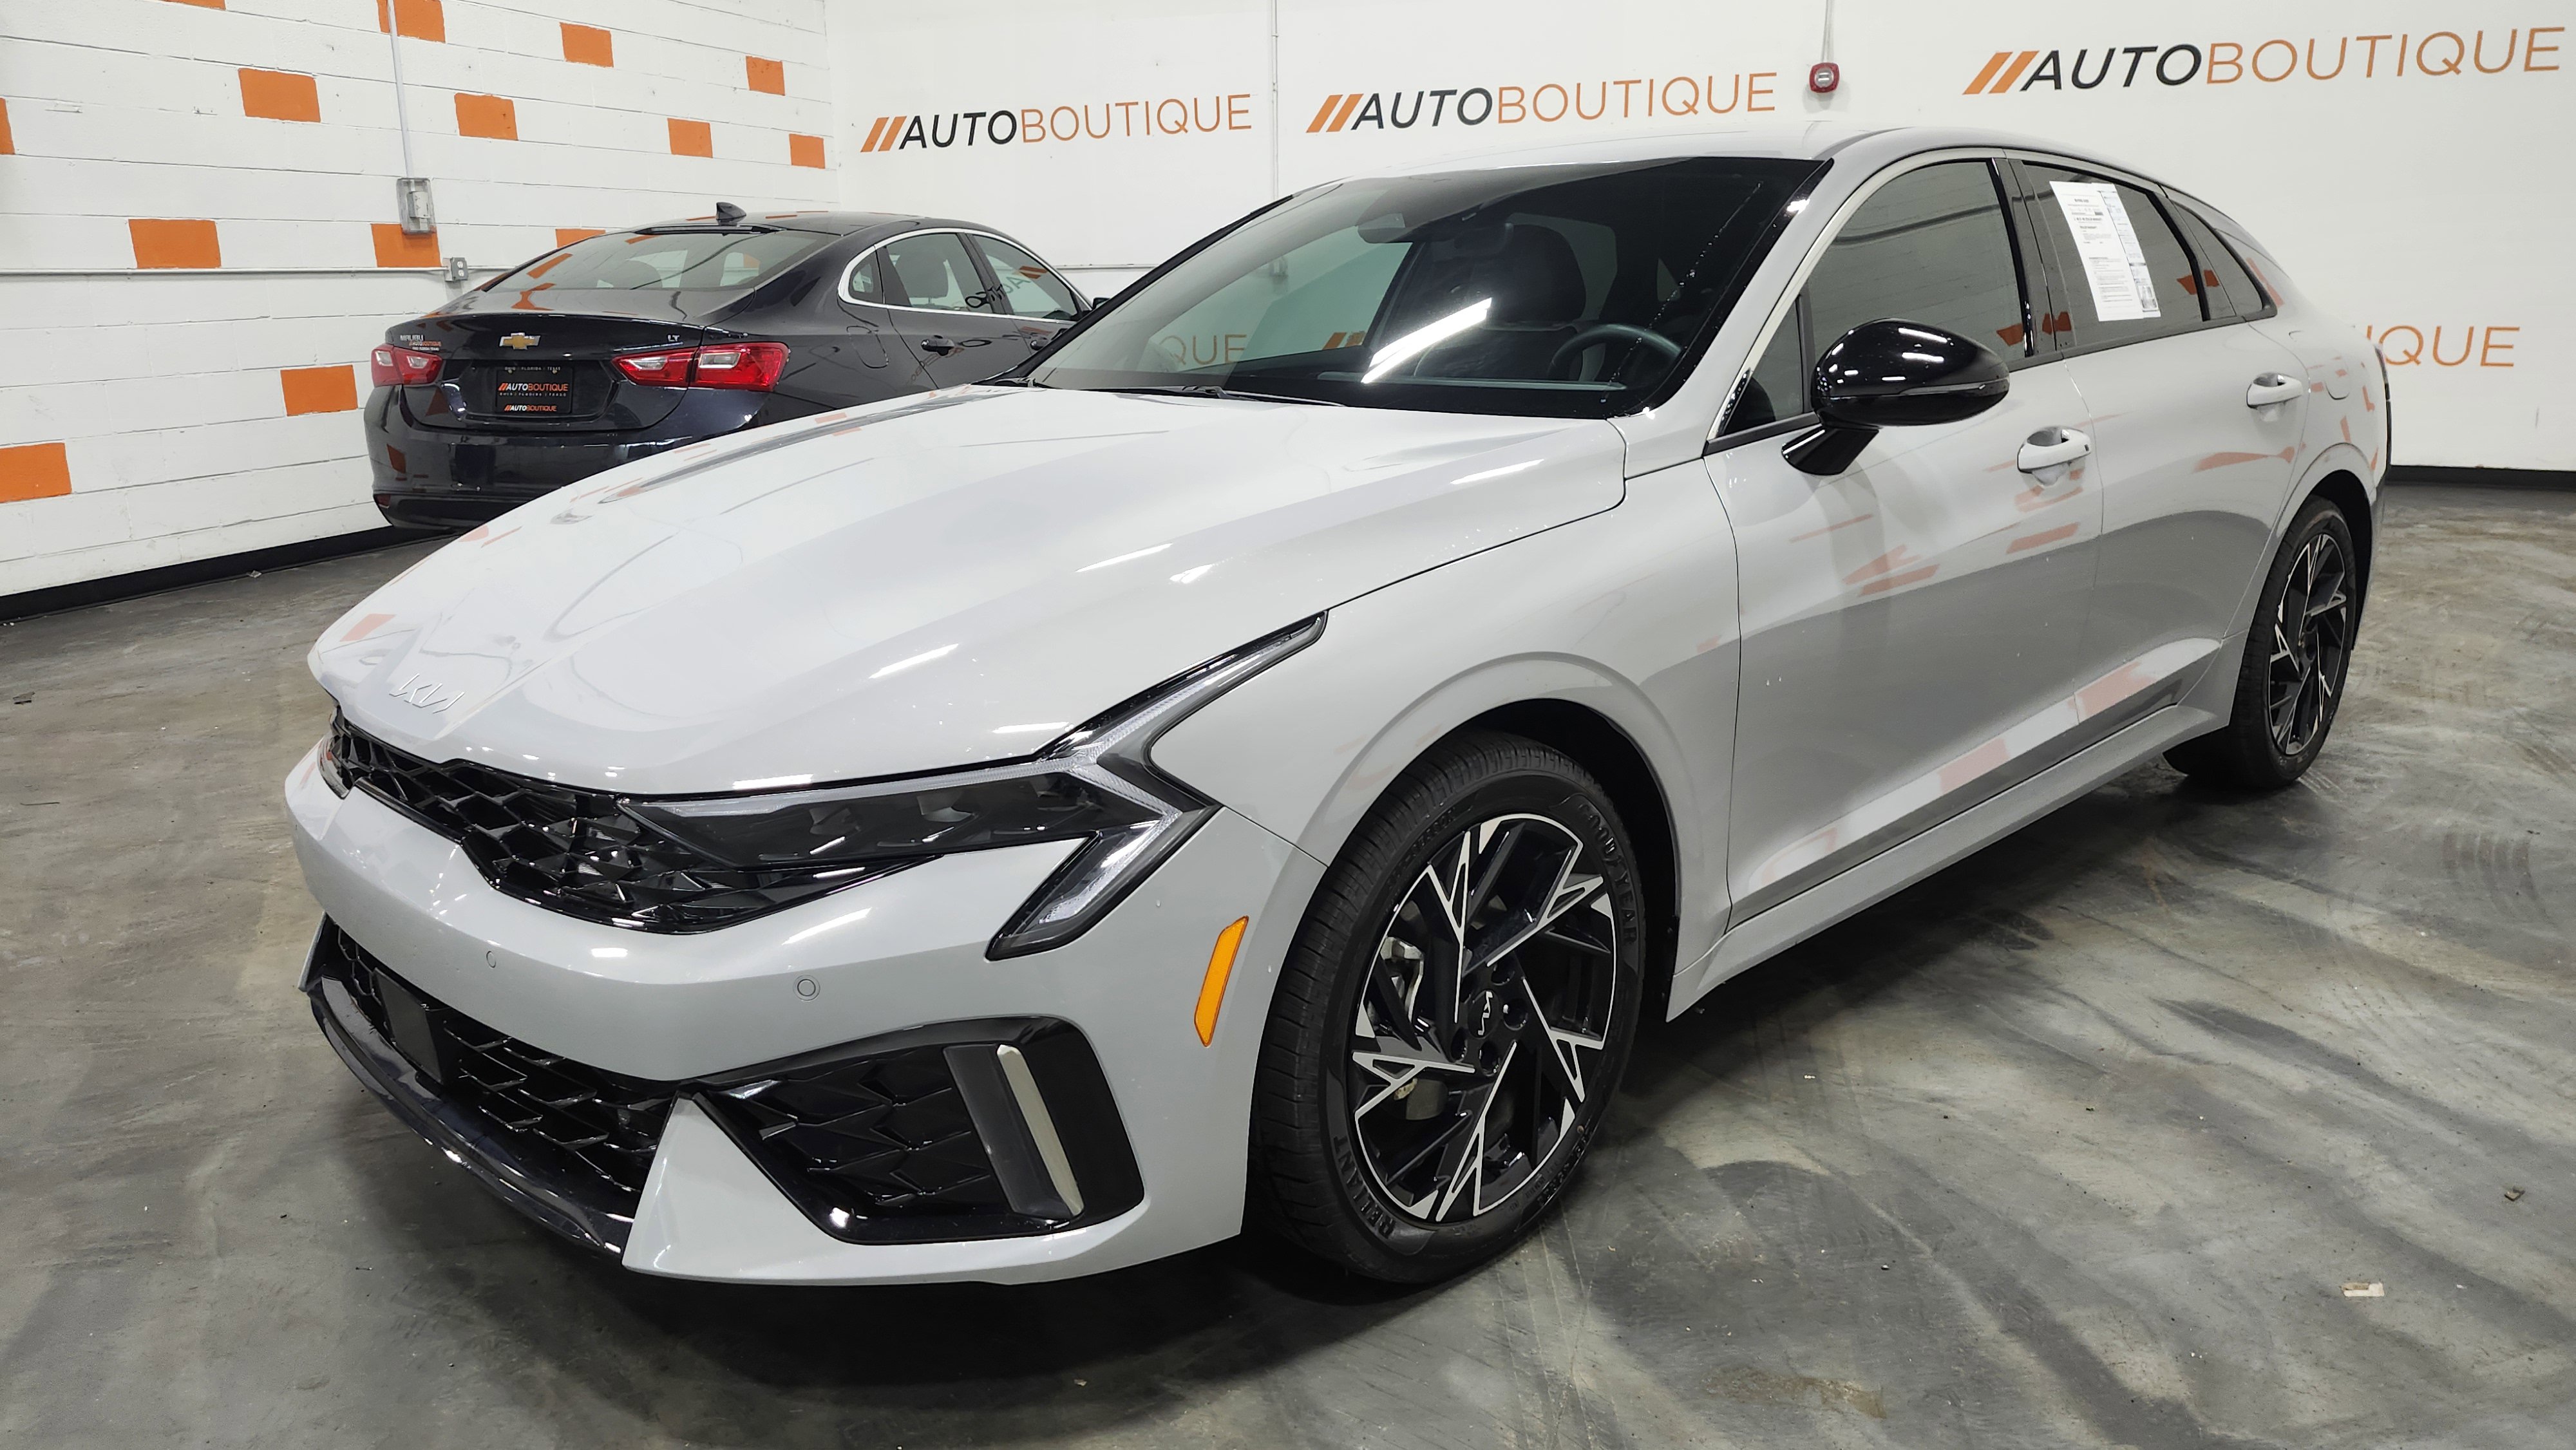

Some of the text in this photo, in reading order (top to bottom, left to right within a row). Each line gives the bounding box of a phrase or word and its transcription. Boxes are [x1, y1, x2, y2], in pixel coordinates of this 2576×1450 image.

[2021, 26, 2565, 92] AUTOBOUTIQUE
[899, 93, 1251, 150] AUTOBOUTIQUE
[1350, 72, 1777, 131] AUTOBOUTIQUE
[506, 383, 569, 391] AUTOBOUTIQUE
[1333, 1136, 1397, 1239] RELIANT
